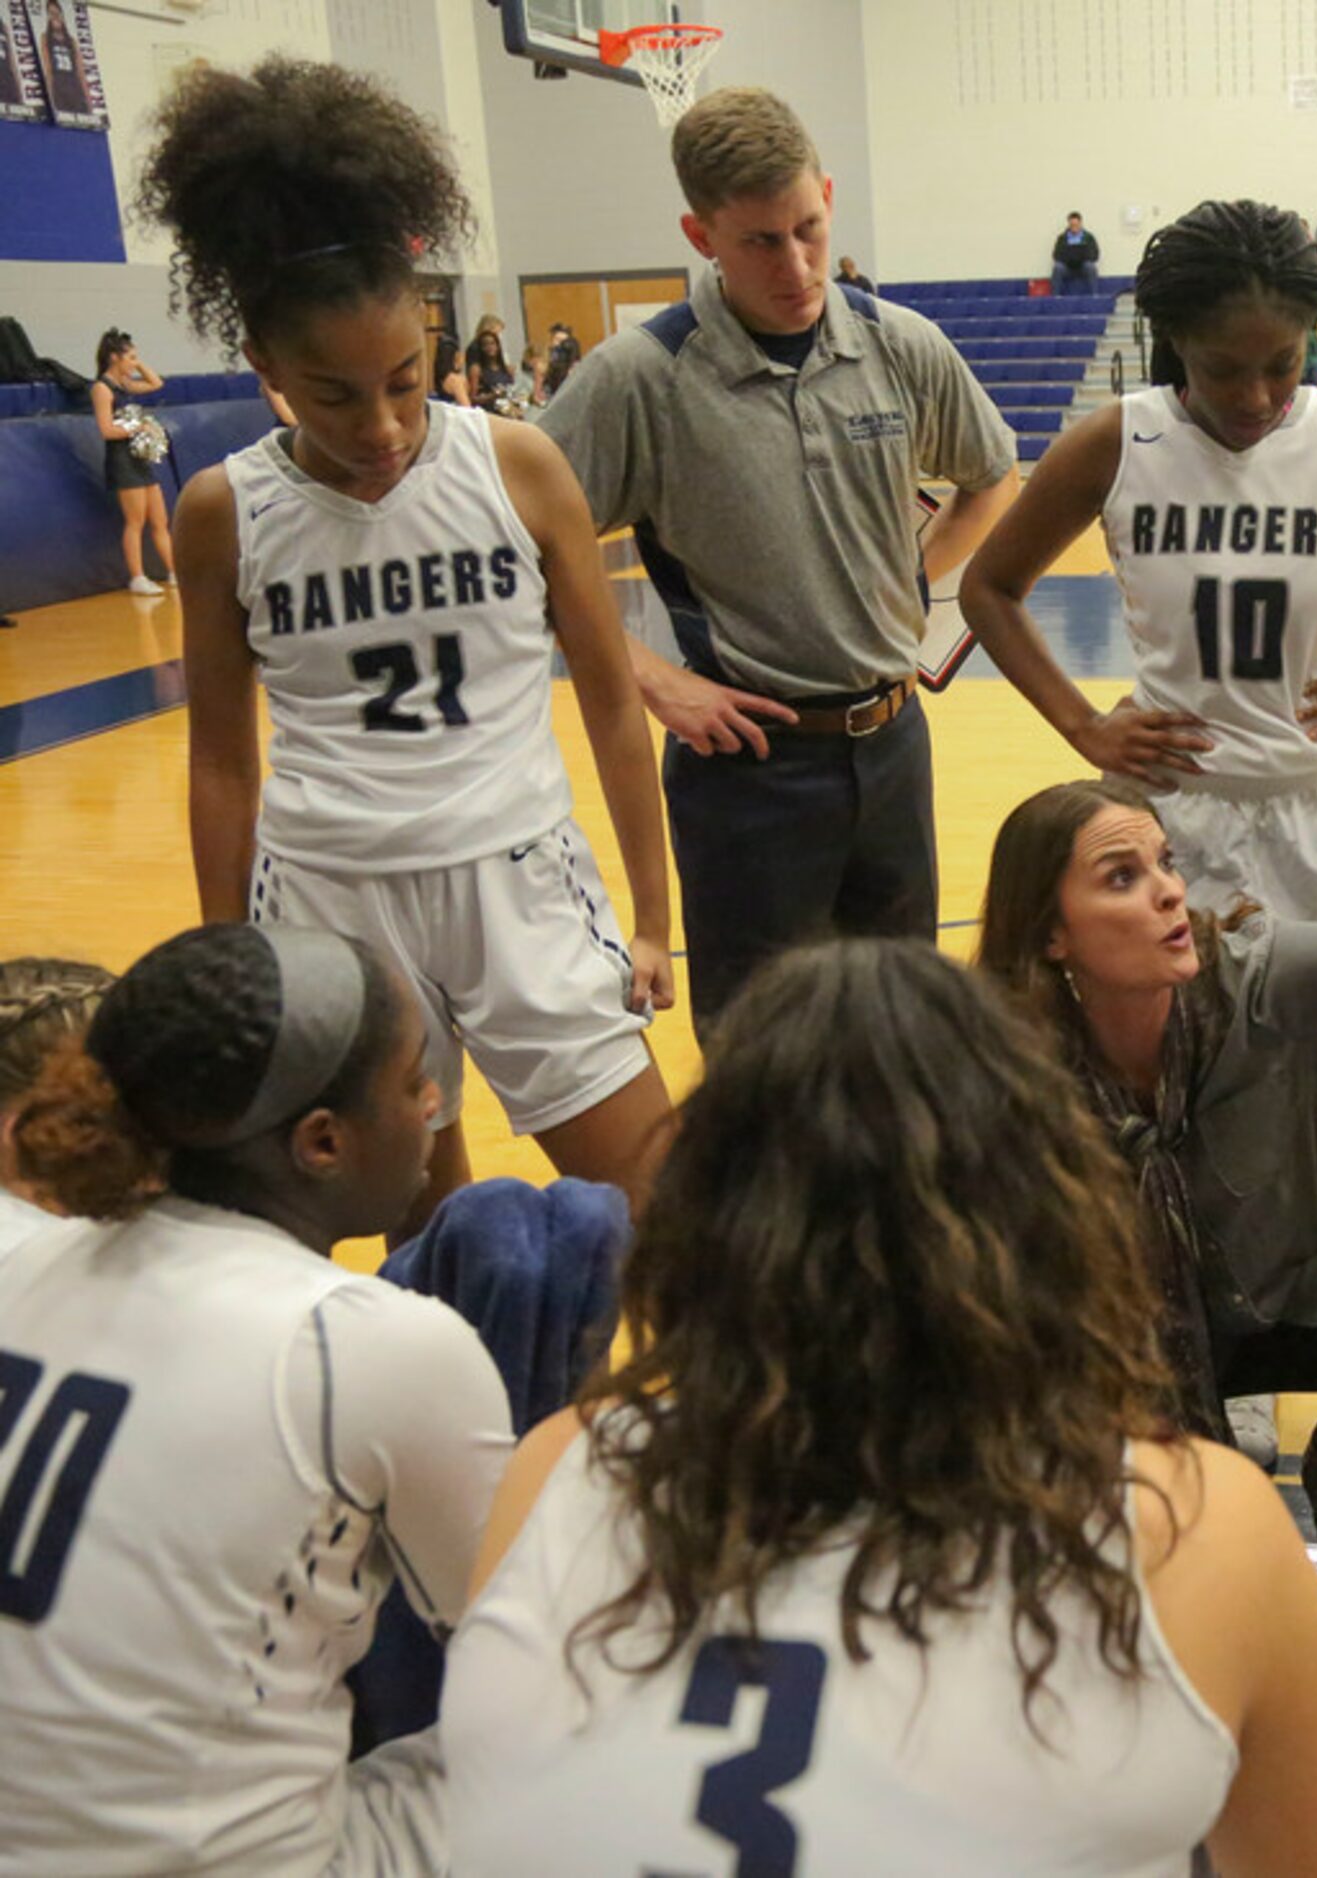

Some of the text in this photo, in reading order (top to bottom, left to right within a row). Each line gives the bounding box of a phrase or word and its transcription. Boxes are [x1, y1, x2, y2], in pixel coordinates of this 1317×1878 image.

[264, 546, 518, 636] RANGERS
[1192, 576, 1290, 682] 10
[350, 632, 470, 732] 21
[645, 1634, 829, 1878] 3
